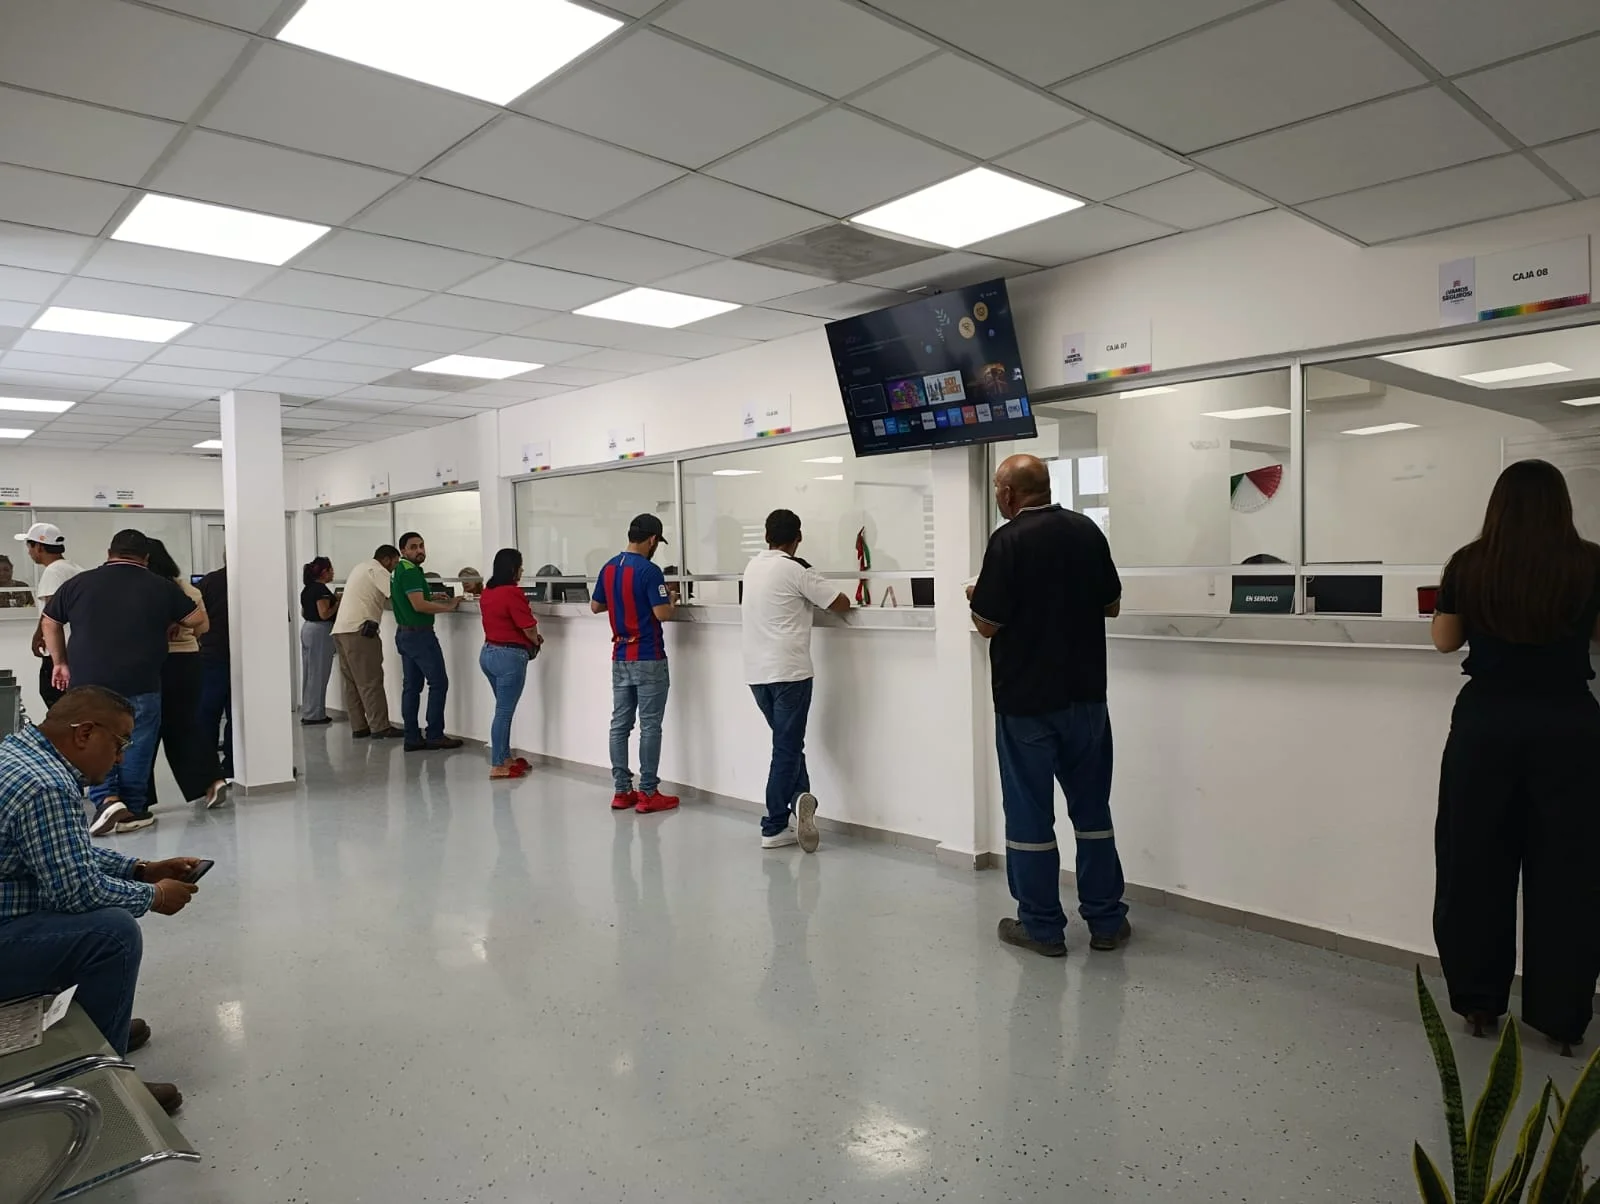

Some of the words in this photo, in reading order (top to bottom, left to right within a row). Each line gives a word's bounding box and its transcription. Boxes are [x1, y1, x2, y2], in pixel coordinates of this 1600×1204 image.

[1512, 271, 1534, 282] CAJA
[1536, 268, 1549, 277] 08
[1105, 344, 1120, 352] CAJA
[1120, 342, 1128, 350] 07
